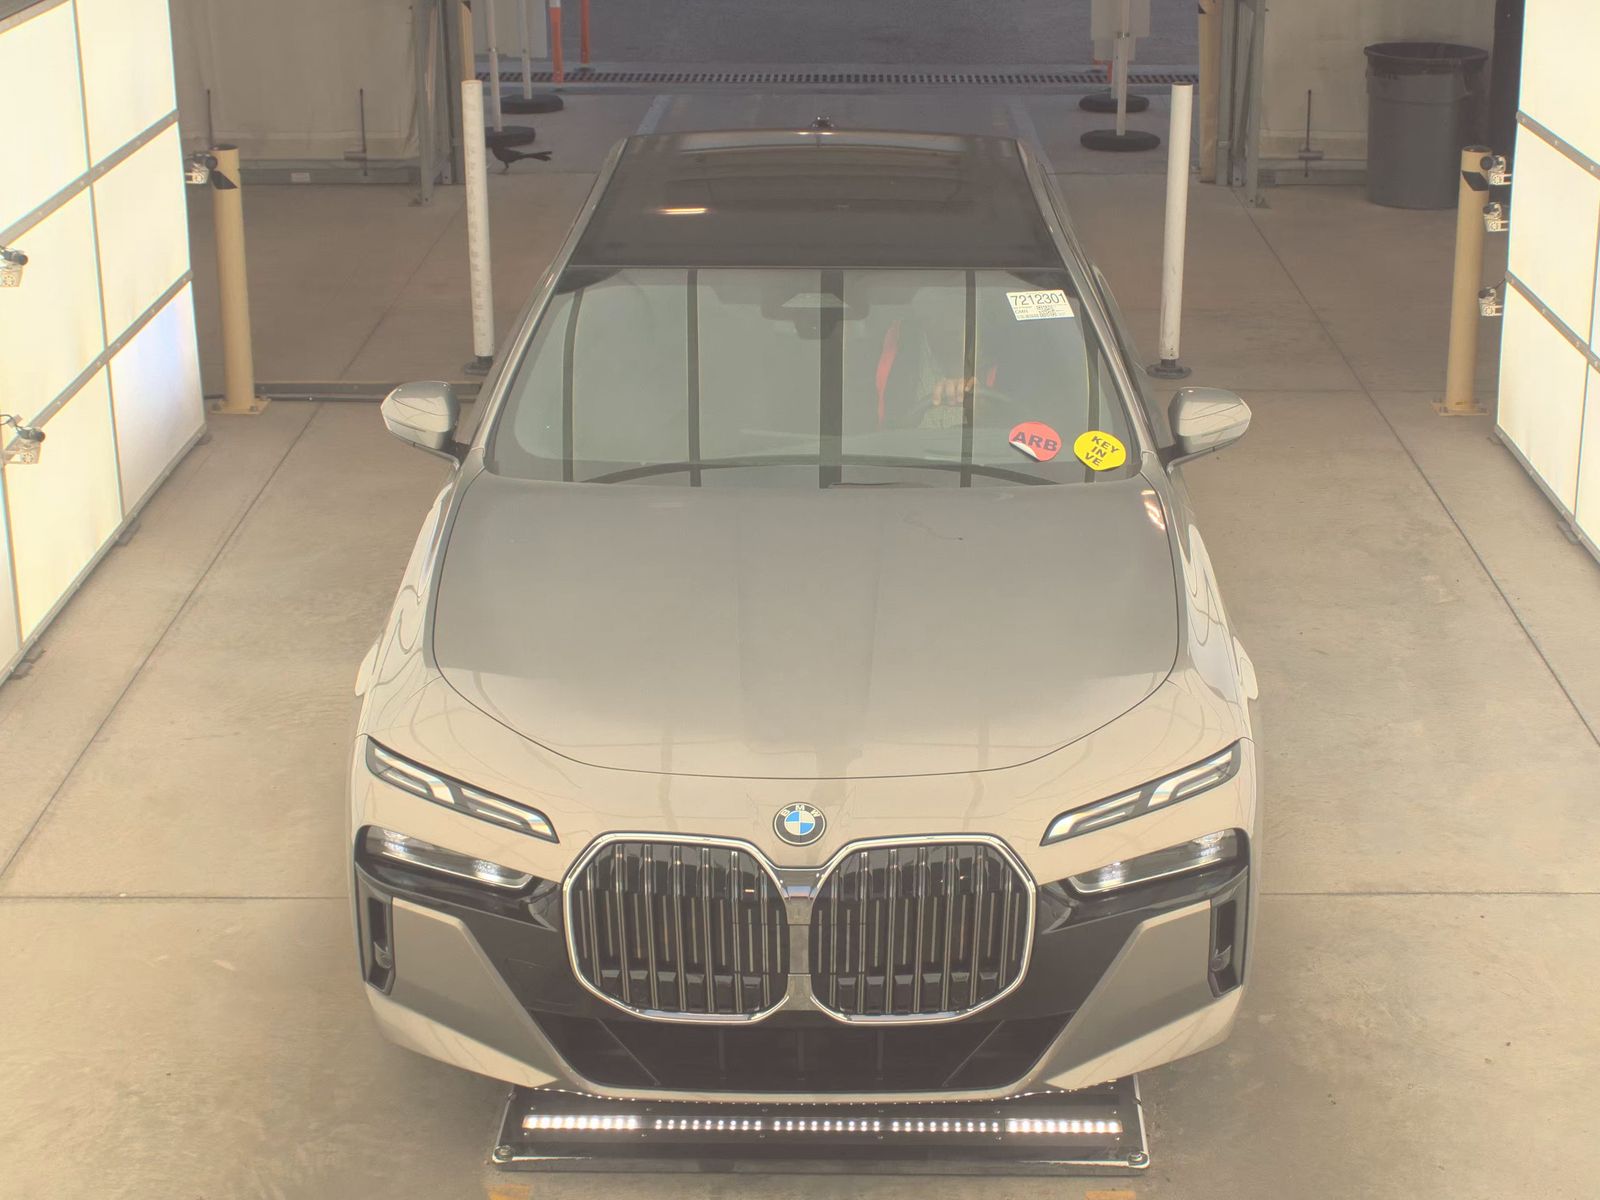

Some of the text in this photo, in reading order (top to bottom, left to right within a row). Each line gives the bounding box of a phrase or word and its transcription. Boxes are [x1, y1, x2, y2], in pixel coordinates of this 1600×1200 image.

[1010, 292, 1066, 306] 7212301
[1012, 431, 1057, 452] ARB
[1091, 435, 1120, 454] KEY
[1084, 452, 1104, 466] VE
[1091, 446, 1107, 458] IN
[780, 804, 821, 818] BMW
